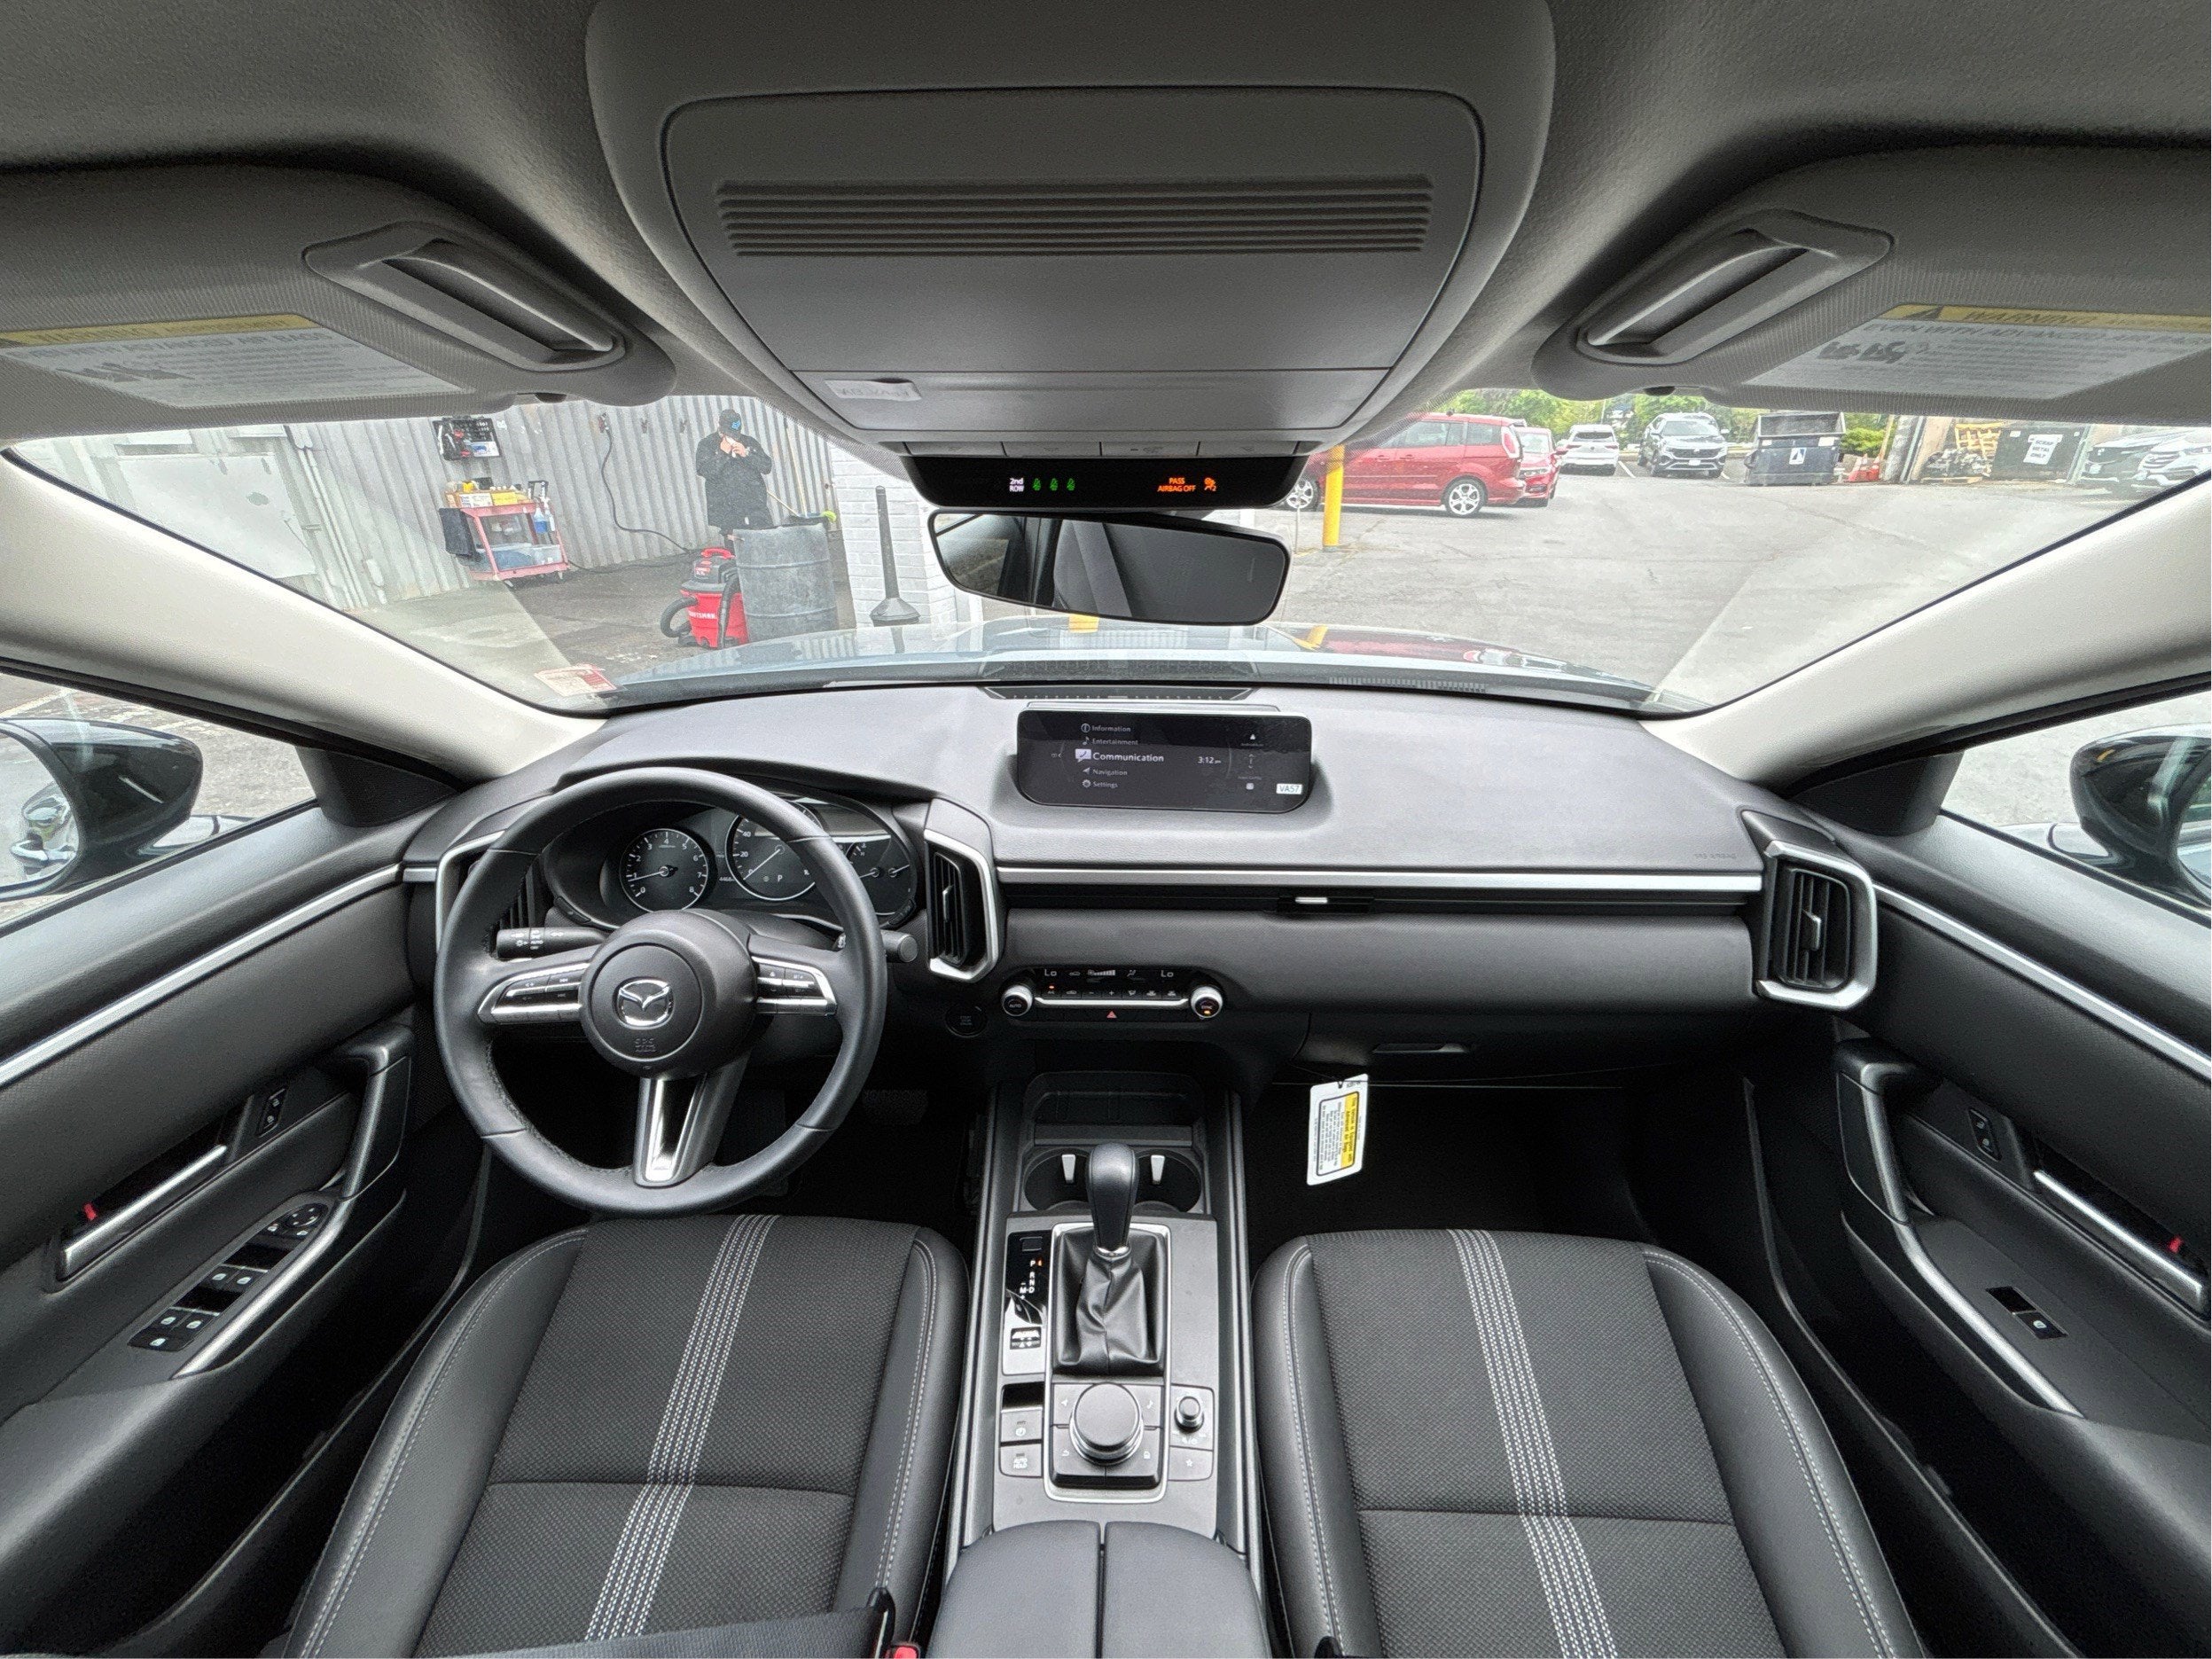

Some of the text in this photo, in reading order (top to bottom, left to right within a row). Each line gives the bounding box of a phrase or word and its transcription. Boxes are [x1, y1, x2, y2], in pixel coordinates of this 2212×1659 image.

[1092, 737, 1139, 746] Entertainment
[1092, 751, 1165, 763] Communication
[1092, 768, 1129, 777] Navigation
[1092, 781, 1119, 790] Settings
